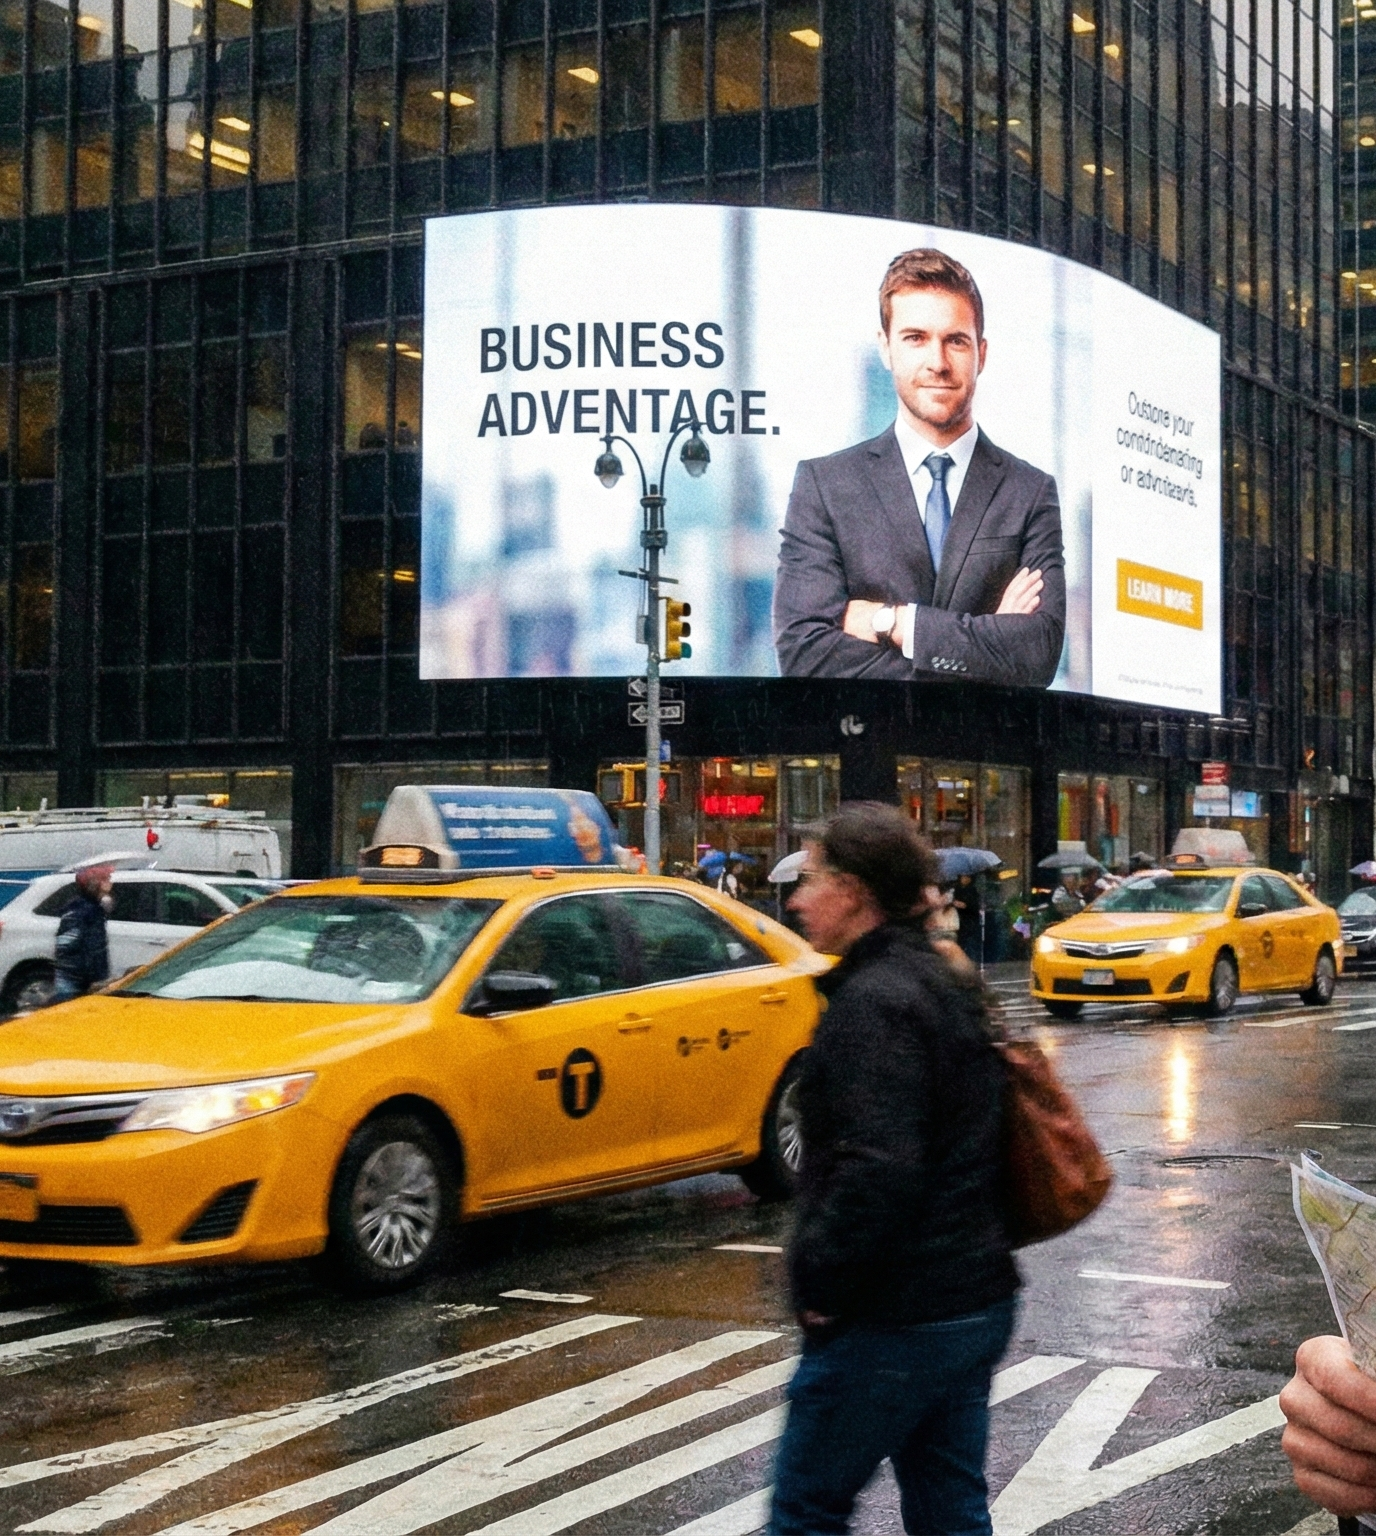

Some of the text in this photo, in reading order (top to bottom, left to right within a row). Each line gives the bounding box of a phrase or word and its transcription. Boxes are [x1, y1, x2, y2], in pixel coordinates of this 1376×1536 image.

[480, 321, 724, 374] BUSINESS
[477, 388, 781, 437] ADVENTAGE.
[1121, 465, 1133, 484] or
[568, 1061, 596, 1110] T
